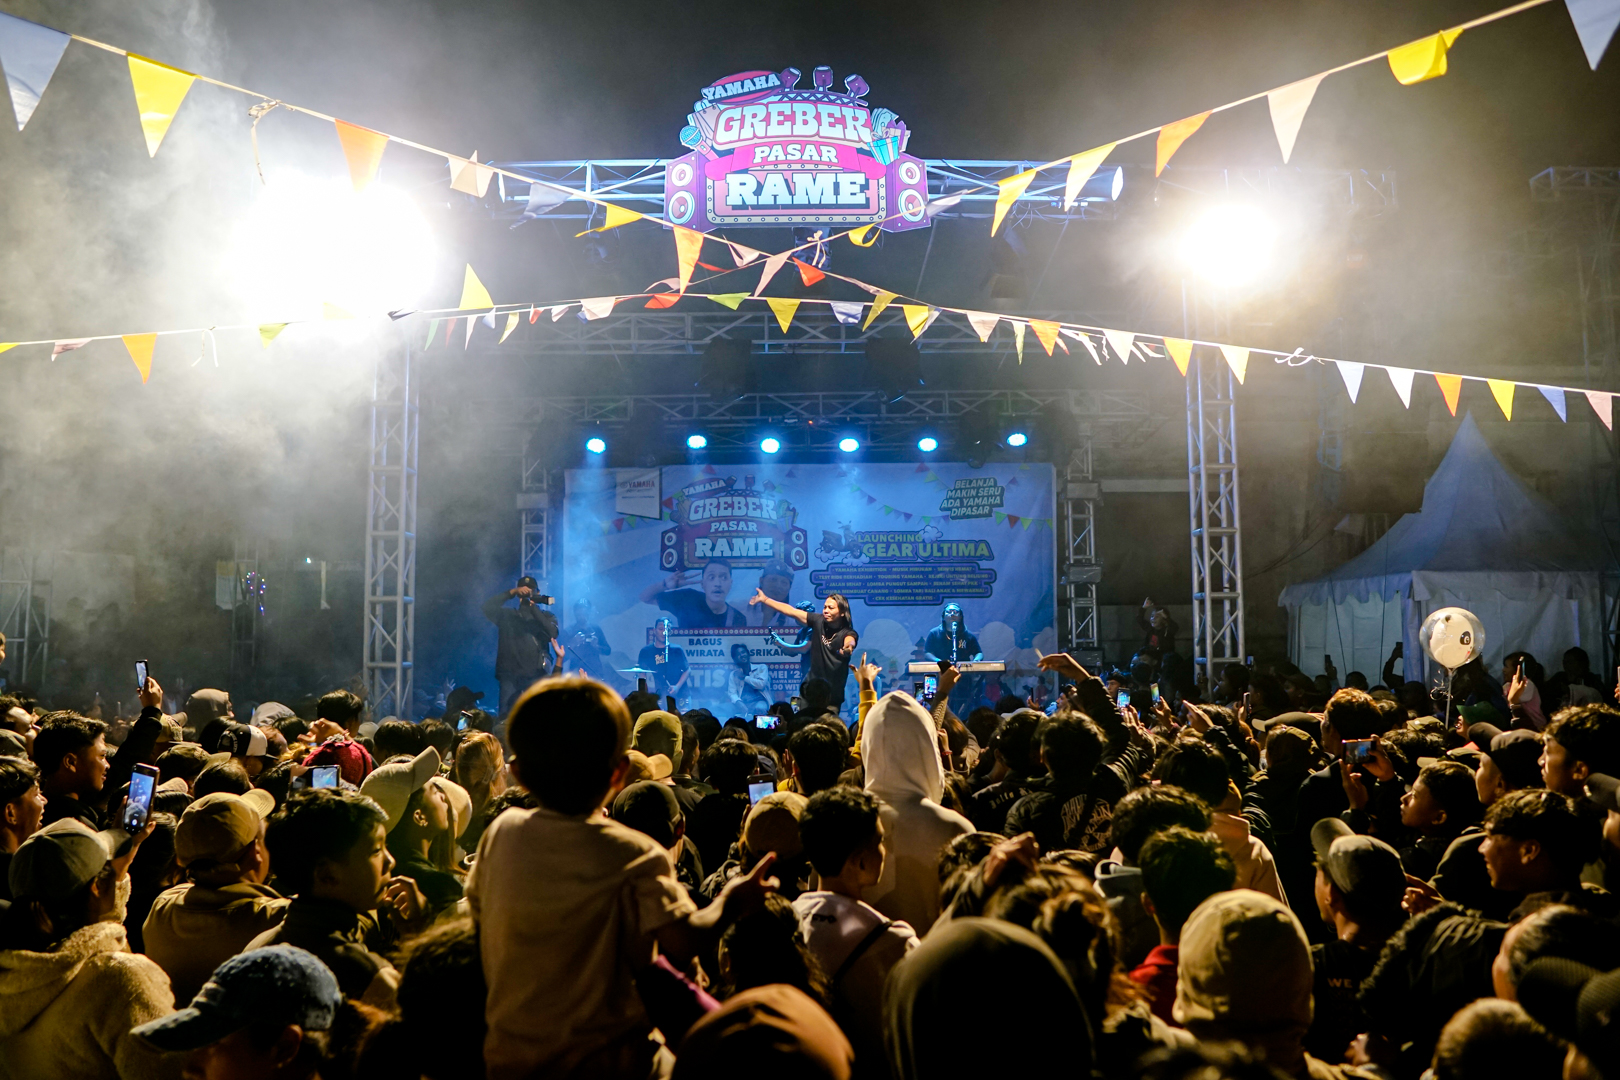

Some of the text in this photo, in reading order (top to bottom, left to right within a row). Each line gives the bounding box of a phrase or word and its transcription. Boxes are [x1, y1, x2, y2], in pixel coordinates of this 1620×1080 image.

[702, 73, 781, 101] YAMAHA
[715, 102, 871, 144] GREBEK
[753, 144, 839, 164] PASAR
[726, 172, 867, 206] RAME
[628, 480, 656, 488] YAMAHA
[683, 480, 726, 496] YAMAHA
[955, 478, 994, 489] BELANJA
[947, 486, 1002, 499] MAKIN SERU
[689, 496, 778, 521] GREBEK
[941, 496, 1001, 508] ADA YAMAHA
[951, 505, 990, 516] DIPASAR
[710, 520, 758, 533] PASAR
[858, 534, 923, 543] LAUNCHING
[694, 537, 773, 557] RAME
[862, 543, 991, 557] GEAR ULTIMA
[688, 638, 722, 646] BAGUS
[685, 649, 725, 657] WIRATA
[1327, 977, 1353, 988] WE
